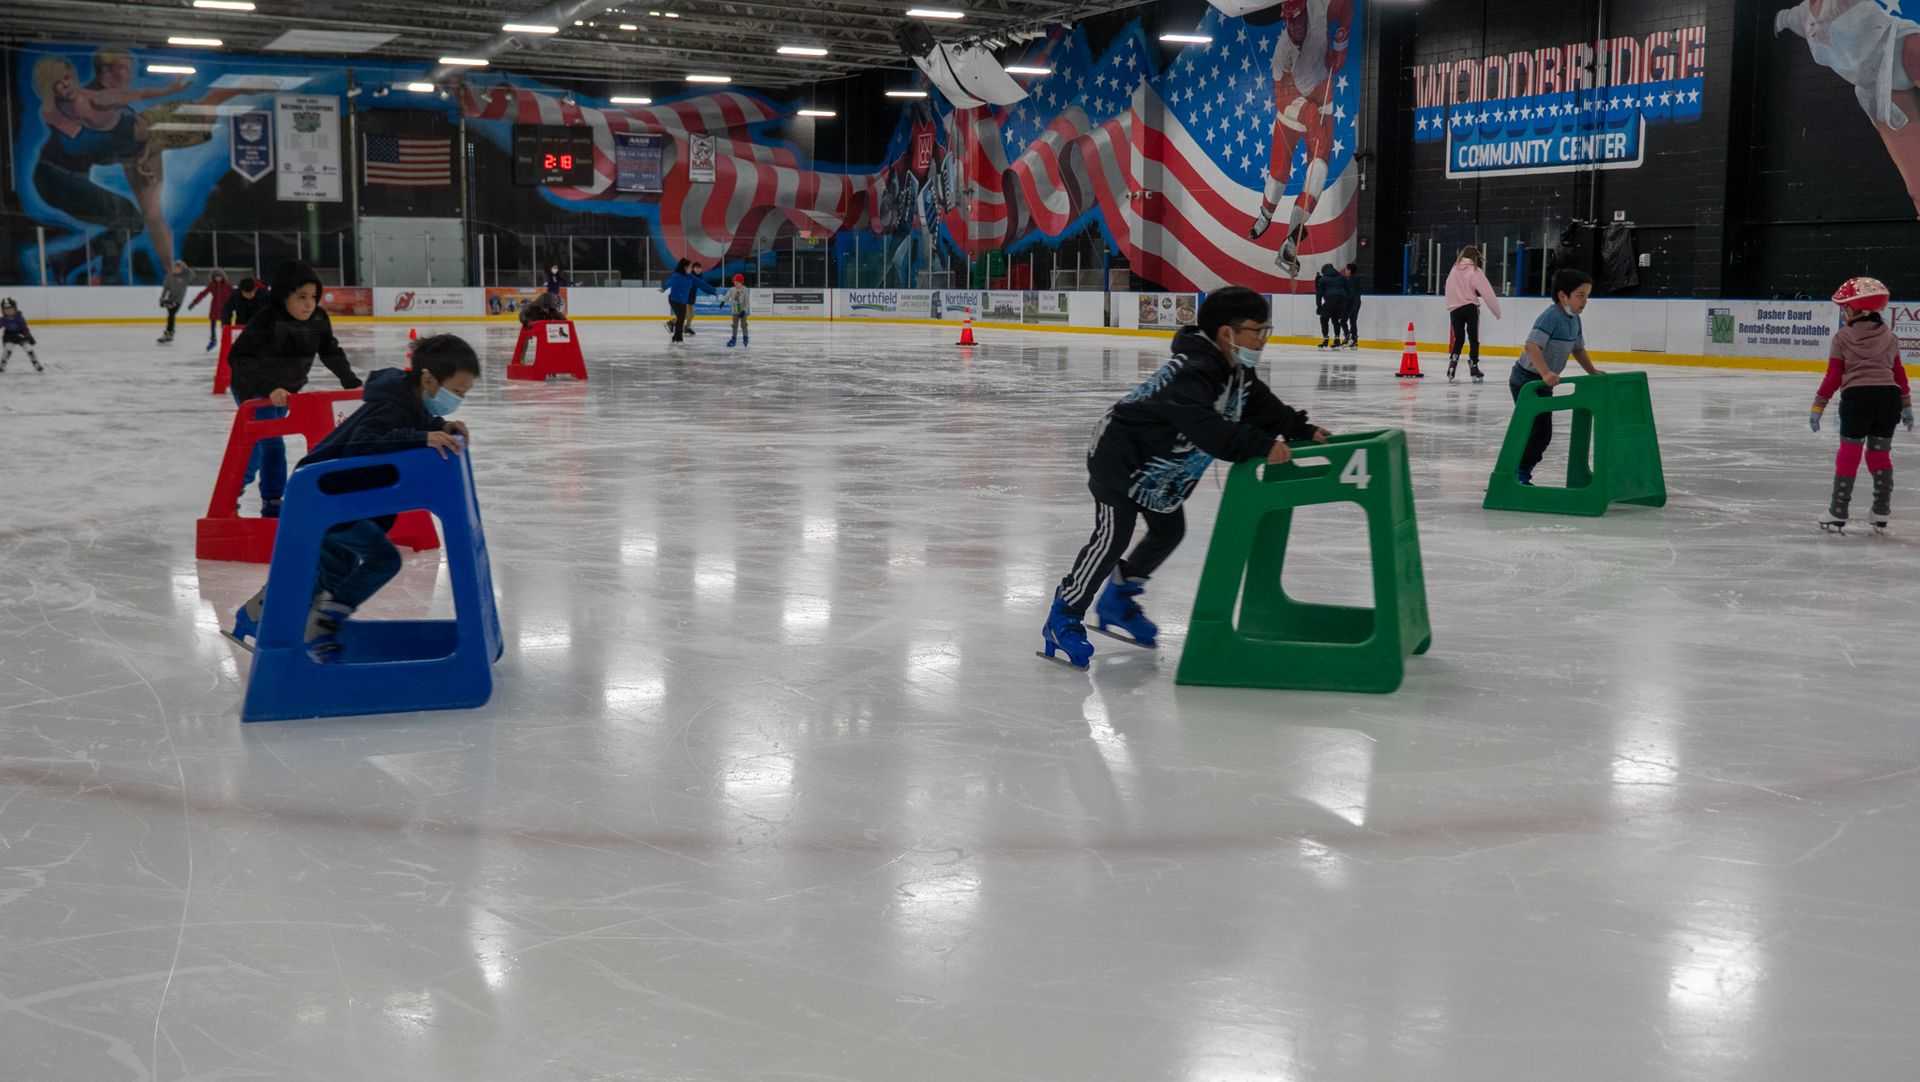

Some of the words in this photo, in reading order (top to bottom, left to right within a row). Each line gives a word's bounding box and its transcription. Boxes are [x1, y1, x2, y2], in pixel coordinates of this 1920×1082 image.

[1413, 26, 1706, 138] WOODBRIDGE
[1458, 139, 1552, 168] COMMUNITY
[1559, 132, 1627, 161] CENTER
[544, 154, 573, 169] 2:18
[849, 291, 897, 305] Northfield
[945, 291, 977, 305] Northfield
[1757, 309, 1785, 320] Dasher
[1787, 310, 1812, 321] Board
[1739, 322, 1764, 334] Rental
[1765, 323, 1790, 335] Space
[1791, 324, 1830, 337] Available
[1339, 448, 1372, 490] 4
